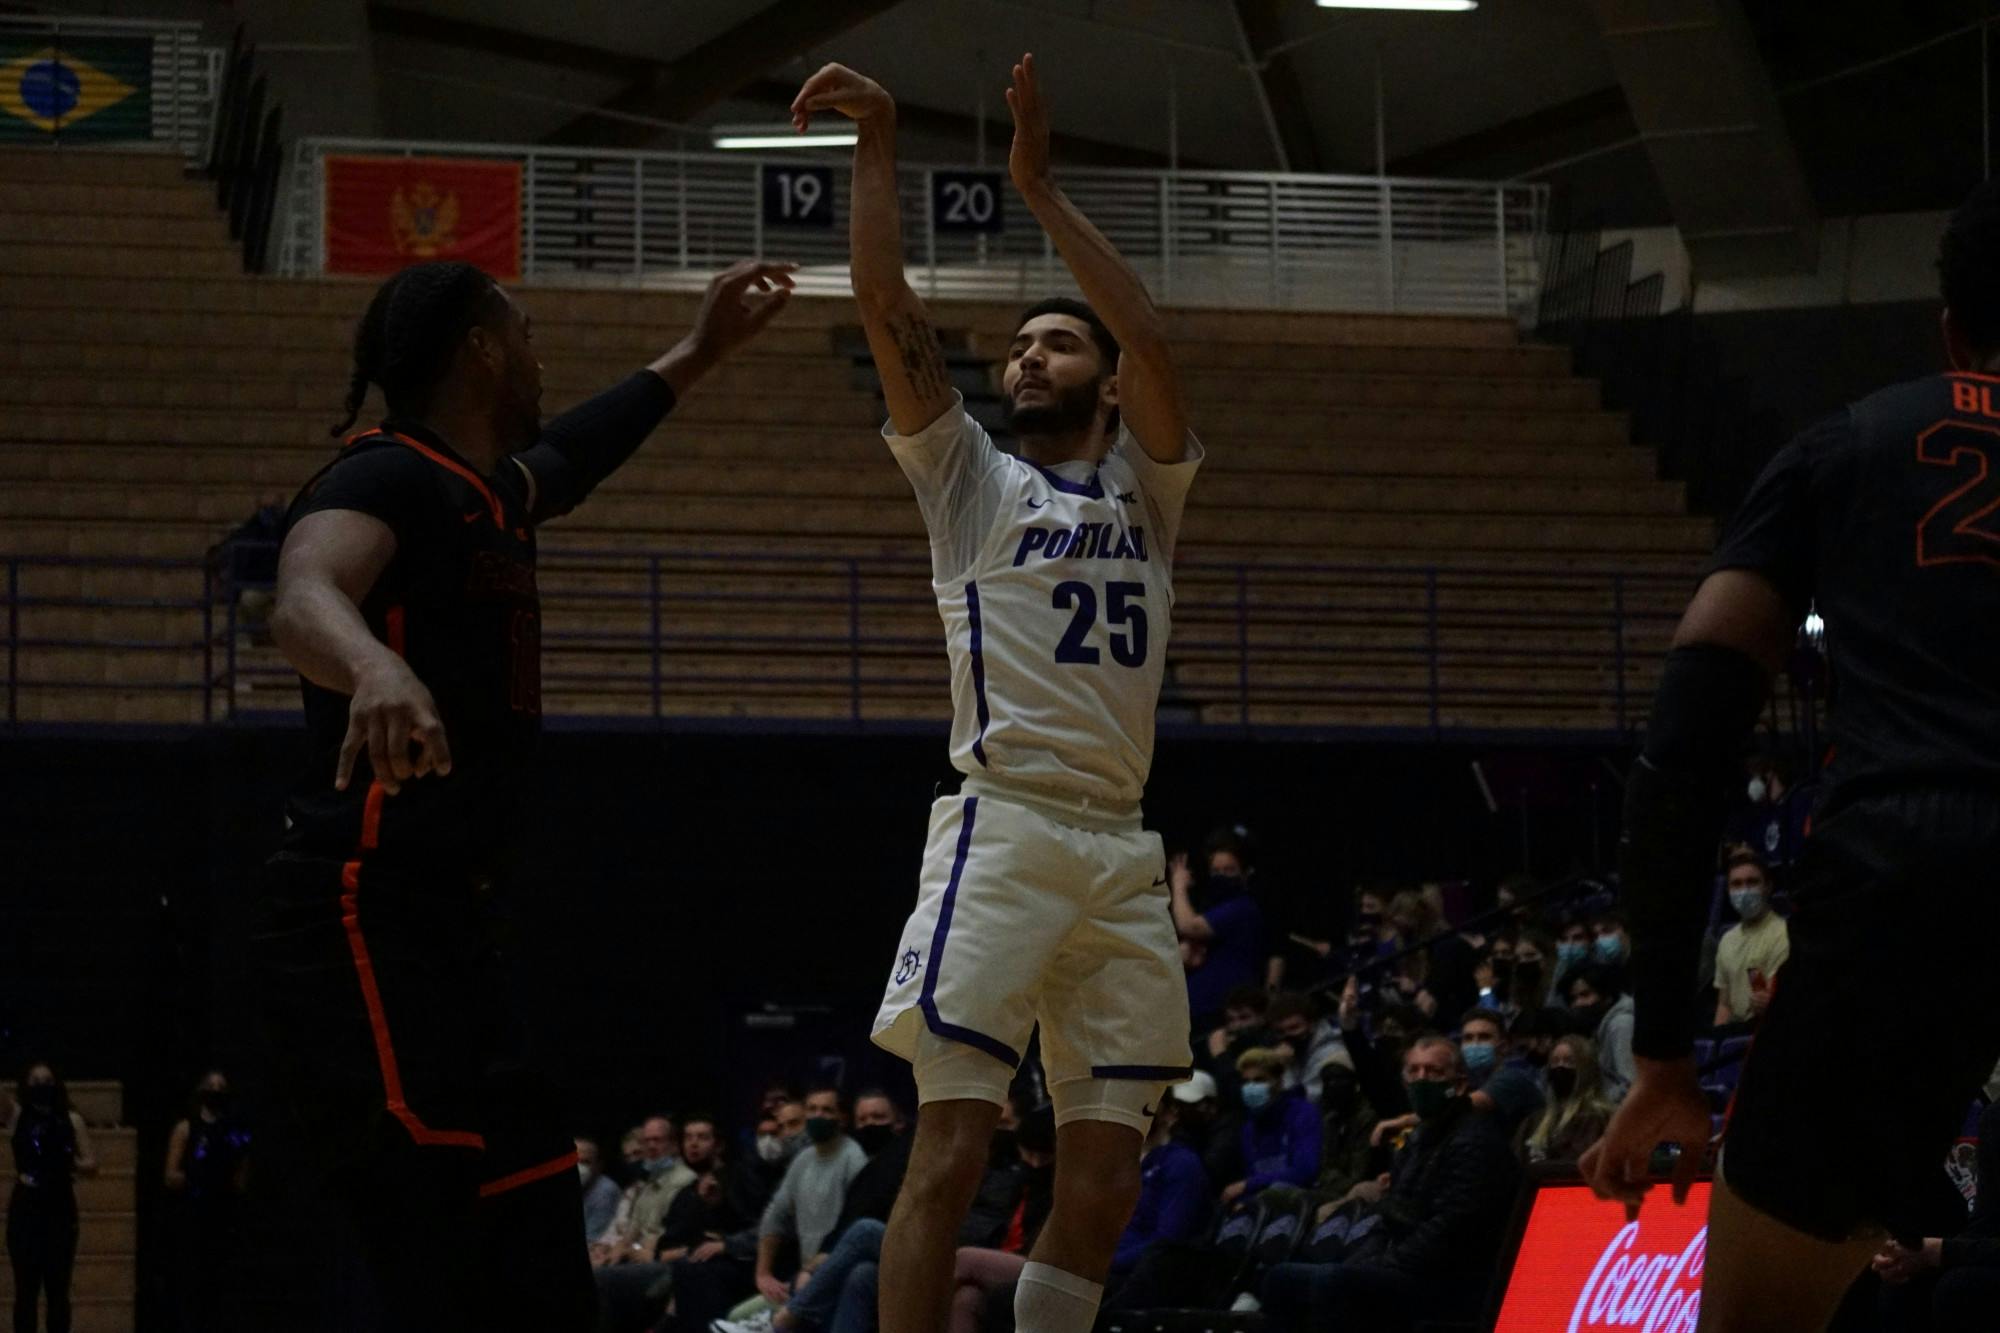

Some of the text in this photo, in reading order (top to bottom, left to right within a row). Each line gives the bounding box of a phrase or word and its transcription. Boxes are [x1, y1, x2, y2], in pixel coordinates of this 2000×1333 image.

[777, 173, 822, 218] 19
[941, 181, 994, 224] 20
[1013, 523, 1148, 567] PORTLAN
[1052, 581, 1148, 668] 25
